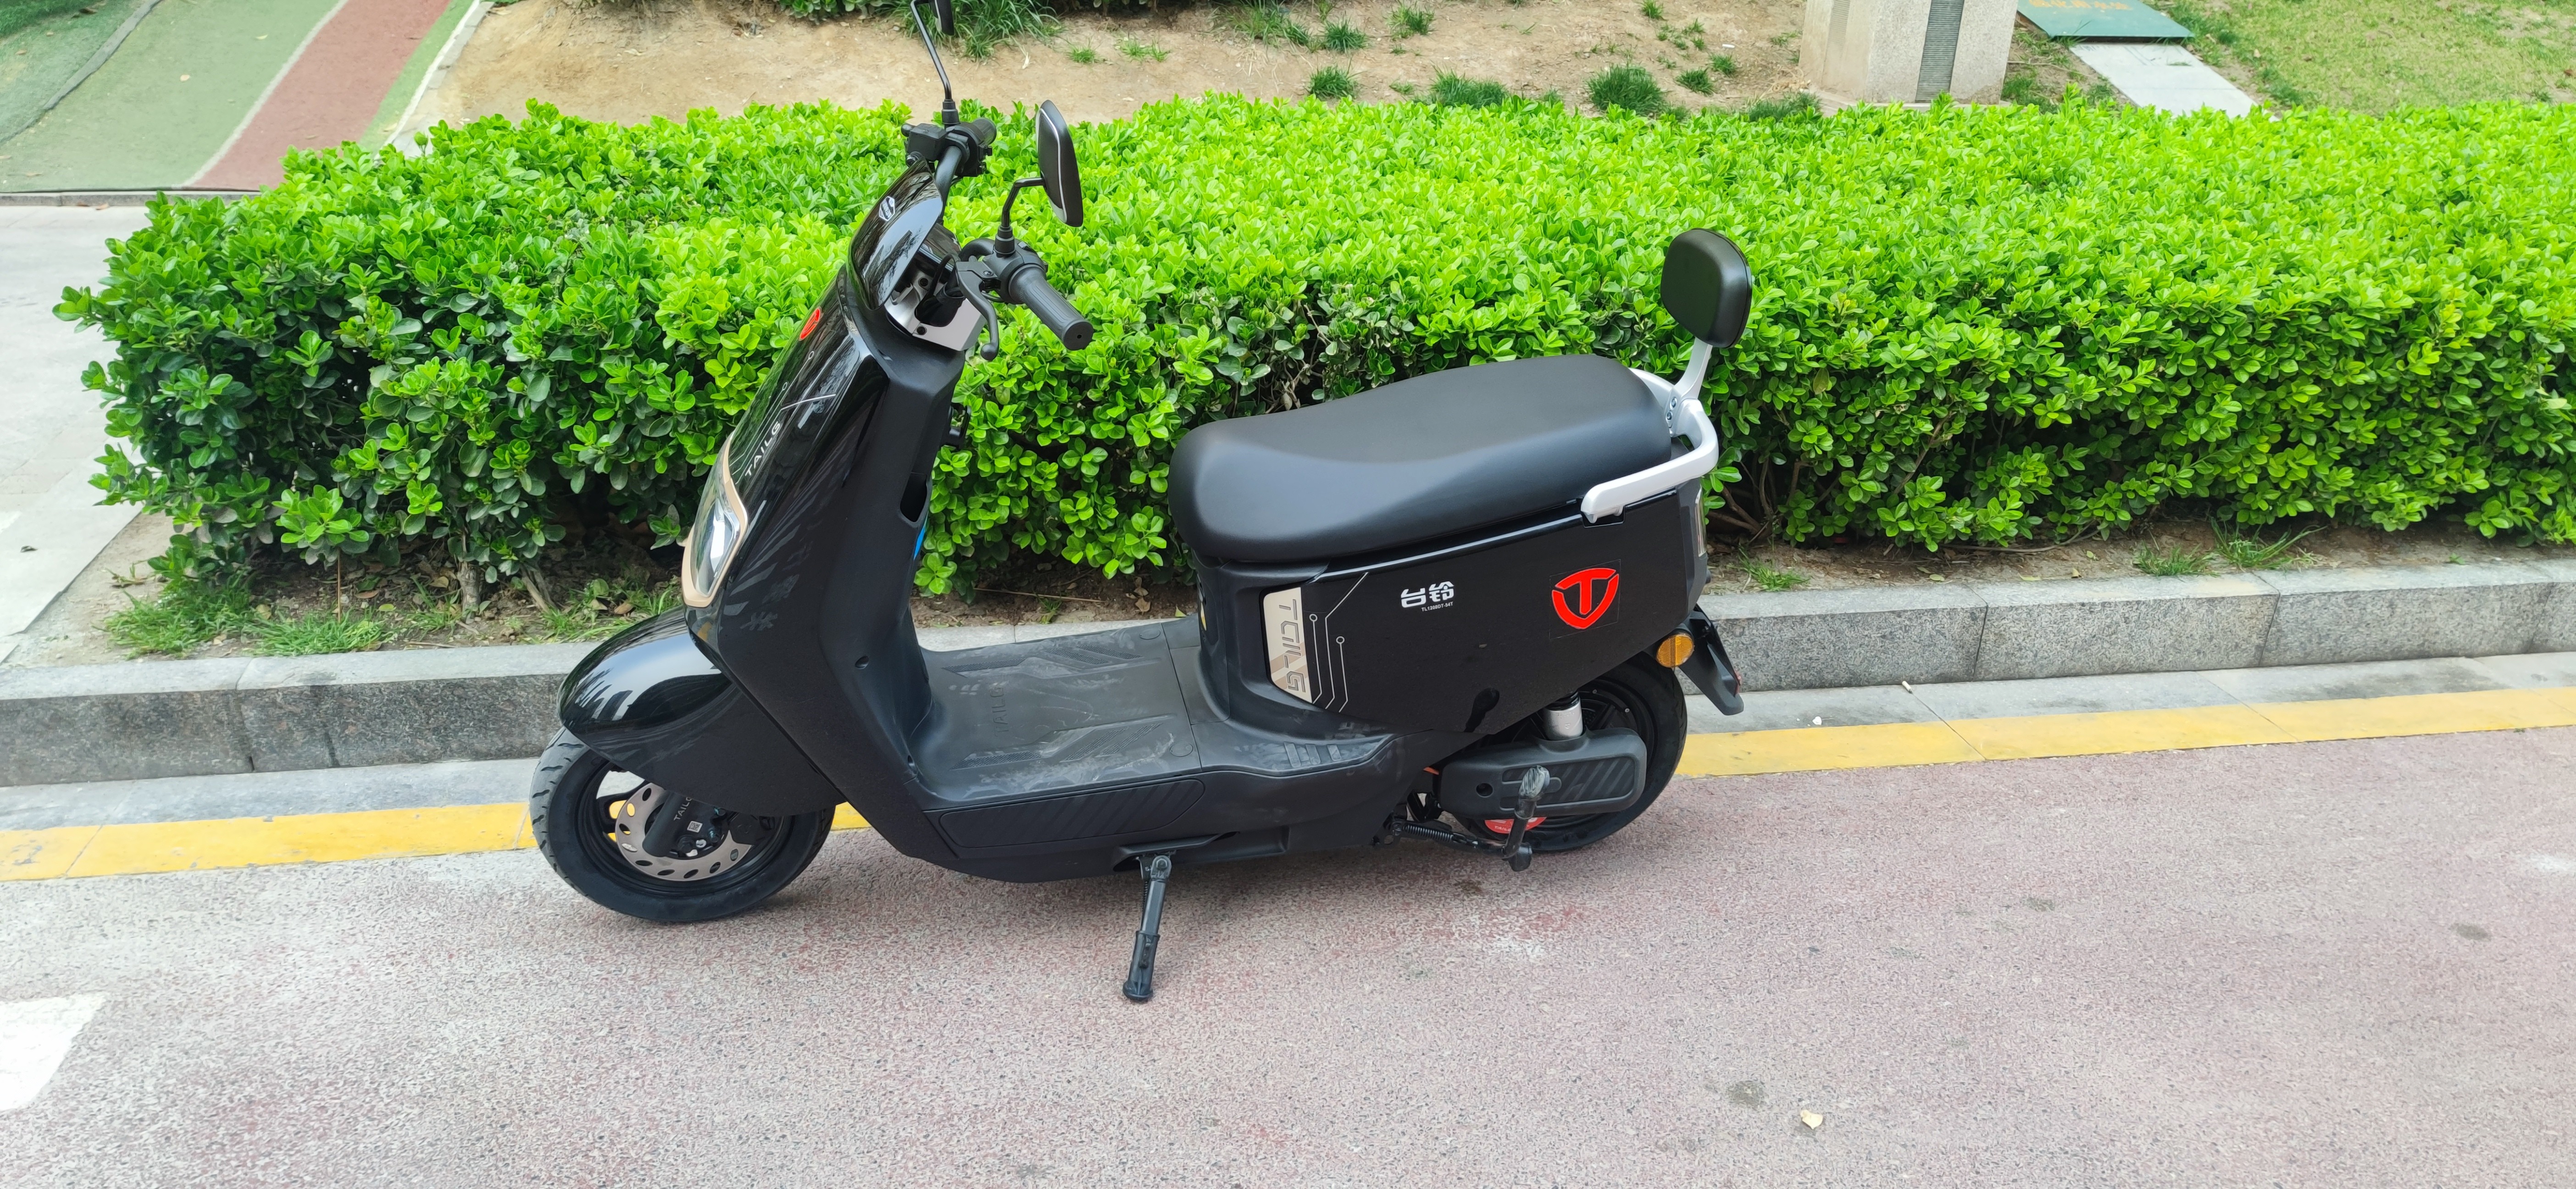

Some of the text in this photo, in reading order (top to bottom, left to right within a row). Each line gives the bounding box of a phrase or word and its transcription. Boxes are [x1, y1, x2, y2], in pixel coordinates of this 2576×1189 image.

[745, 421, 780, 476] TAILG
[1401, 581, 1455, 608] 台铃
[1279, 599, 1306, 693] TAILG
